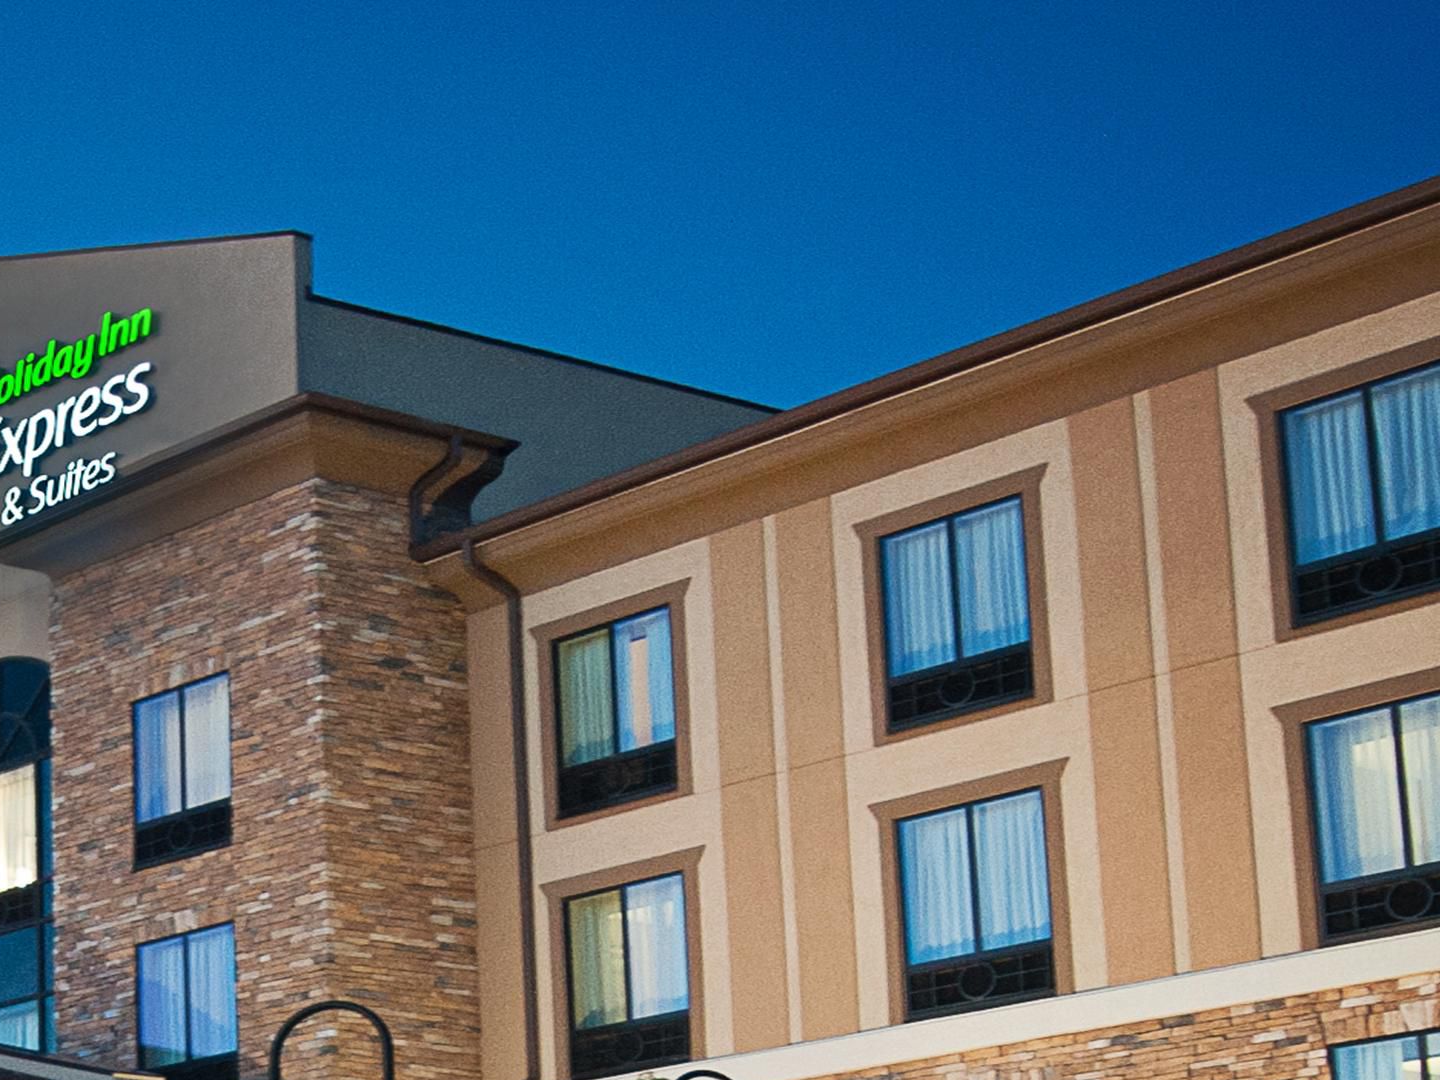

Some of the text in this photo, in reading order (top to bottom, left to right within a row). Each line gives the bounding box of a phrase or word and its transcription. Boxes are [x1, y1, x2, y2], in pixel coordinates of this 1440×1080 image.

[98, 308, 152, 357] Inn
[0, 451, 117, 526] & Suites
